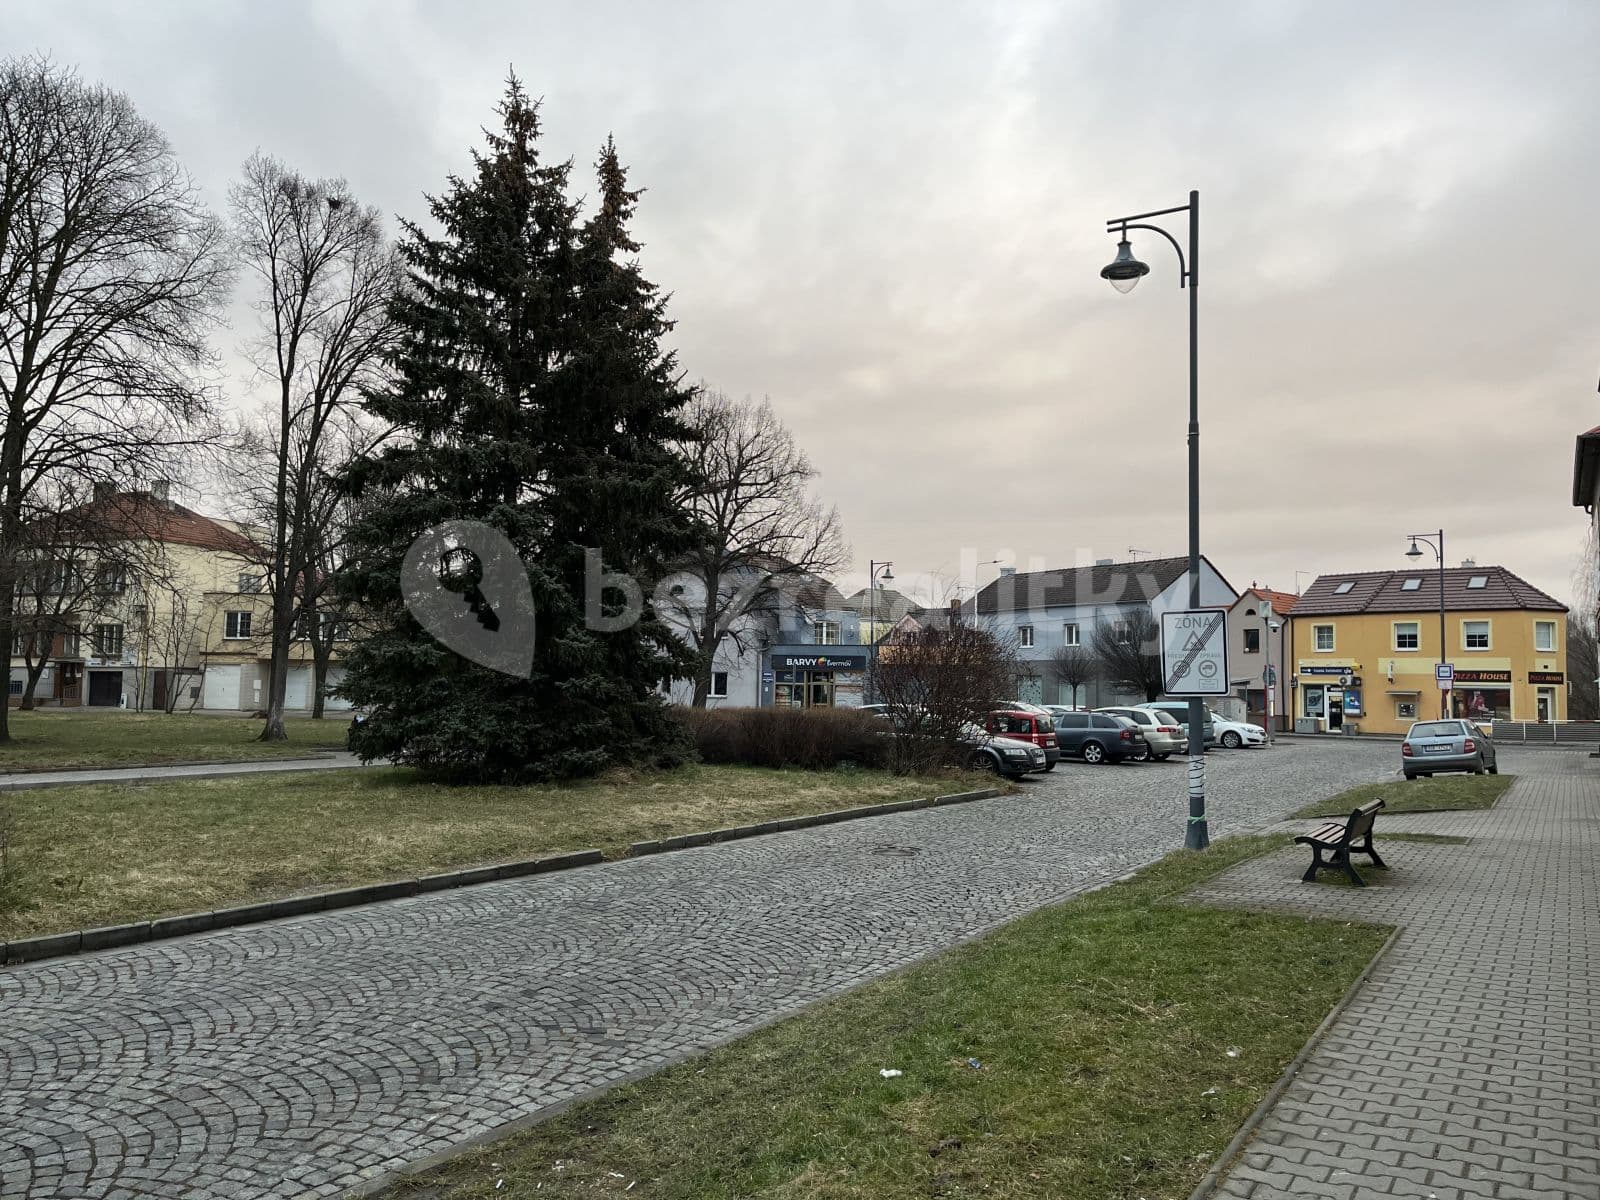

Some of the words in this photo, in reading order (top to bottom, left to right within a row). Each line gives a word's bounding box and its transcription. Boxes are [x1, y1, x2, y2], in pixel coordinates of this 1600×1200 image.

[1174, 614, 1212, 629] ZÓNA
[786, 658, 817, 666] BARVY
[1479, 672, 1508, 680] HOUSE
